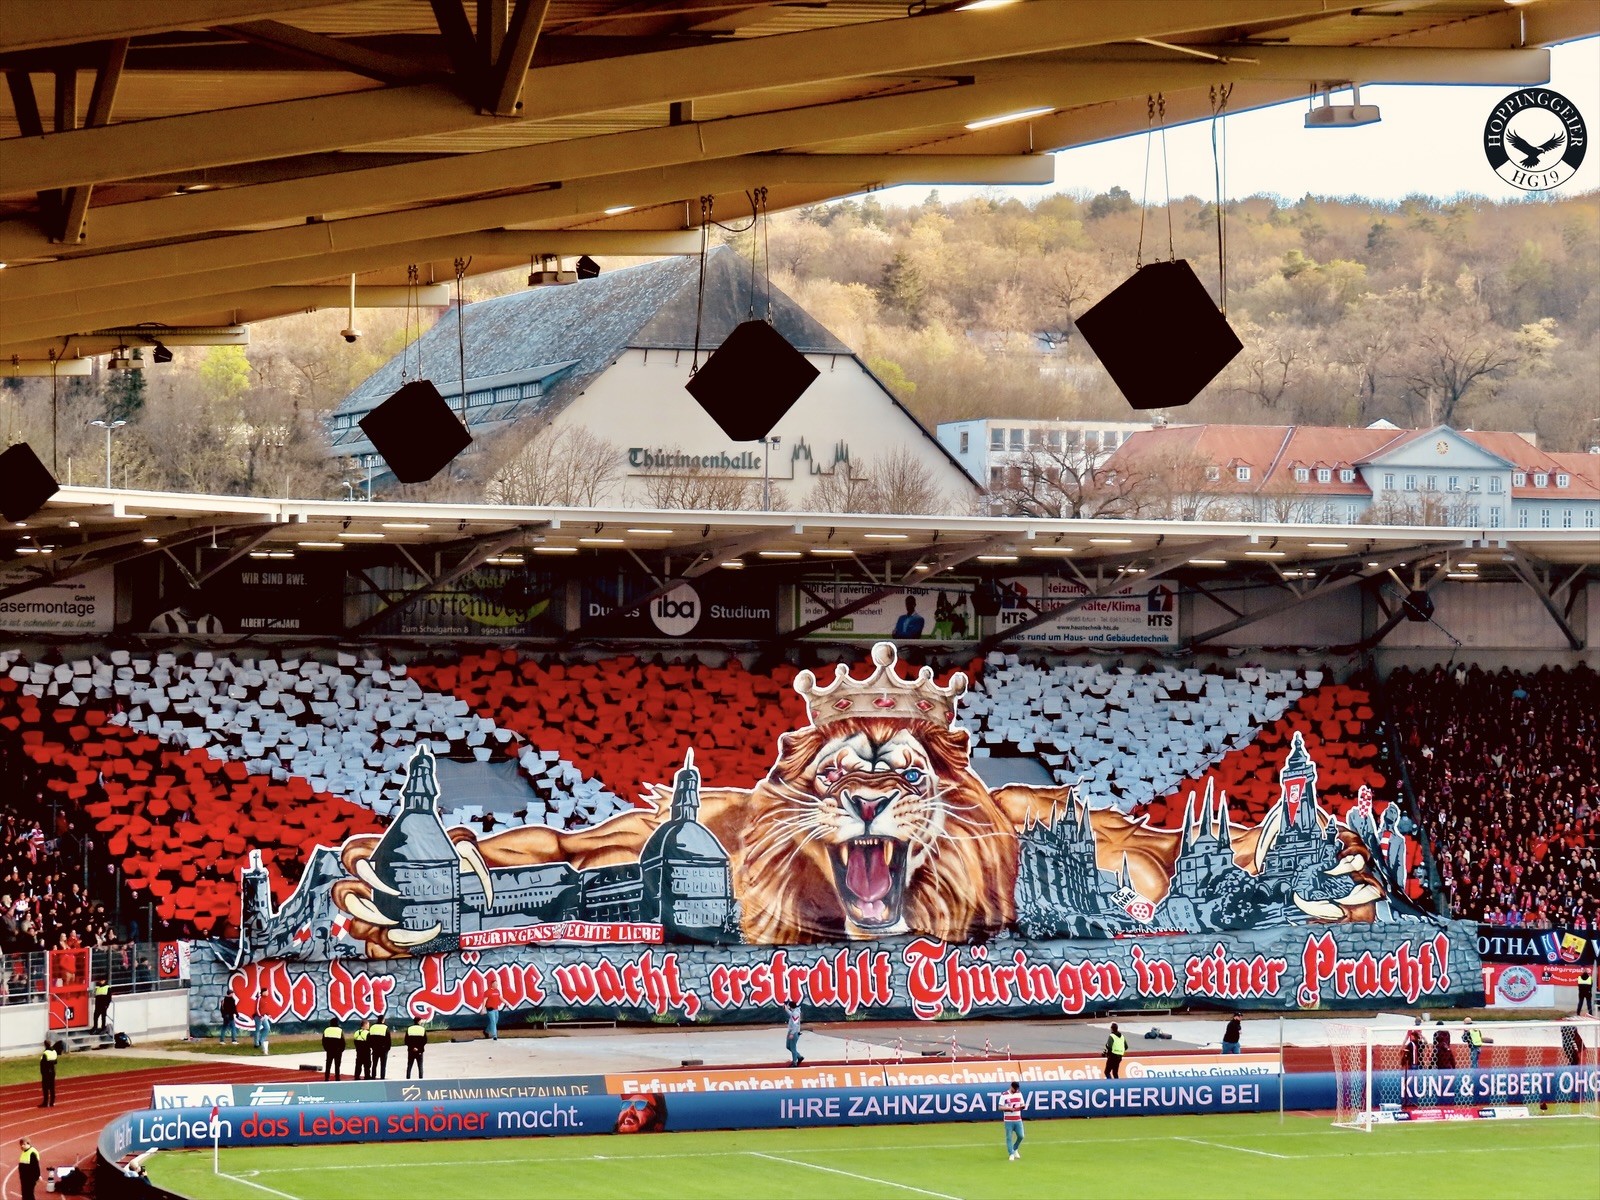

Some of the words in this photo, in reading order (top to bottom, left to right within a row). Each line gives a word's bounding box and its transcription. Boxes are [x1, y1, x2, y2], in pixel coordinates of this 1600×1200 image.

[628, 447, 762, 470] Thüringenhalle
[242, 572, 259, 584] WIR
[262, 573, 283, 585] SIND
[286, 574, 308, 586] RWE.
[657, 595, 695, 618] iba
[710, 604, 771, 619] Studium
[241, 618, 266, 628] ALBERT
[1001, 612, 1028, 624] HTS
[1147, 615, 1173, 627] HTS
[401, 626, 418, 634] Zum
[419, 626, 463, 635] Schulgarten
[481, 628, 503, 636] 99092
[505, 627, 526, 635] Erfurt
[1027, 634, 1047, 642] rund
[1063, 634, 1086, 642] Haus-
[1106, 634, 1170, 643] Gebäudetechnik
[1113, 891, 1125, 901] FC
[1118, 892, 1136, 908] RWE
[462, 926, 550, 947] THÜRINGENS
[566, 923, 612, 940] ECHTE
[618, 925, 661, 941] LIEBE
[1476, 936, 1540, 955] OTHA
[229, 957, 316, 1031] Wo
[325, 957, 397, 1022] der
[408, 951, 545, 1025] Löwe
[553, 948, 701, 1022] wacht,
[710, 948, 896, 1016] erstrahlt
[903, 937, 1125, 1021] Thüringen
[1131, 944, 1178, 1000] in
[1184, 942, 1288, 1000] seiner
[1296, 930, 1450, 1008] Pracht!
[622, 1078, 697, 1094] Erfurt
[703, 1072, 794, 1091] kontert
[801, 1072, 837, 1089] mit
[844, 1064, 1102, 1088] Lichtgeschwindigkeit
[1146, 1067, 1207, 1079] Deutsche
[1209, 1066, 1270, 1078] GigaNetz
[1401, 1075, 1456, 1099] KUNZ
[1460, 1075, 1475, 1097] &
[1479, 1072, 1558, 1096] SIEBERT
[780, 1098, 842, 1119] IHRE
[1221, 1084, 1260, 1105] BEI
[139, 1114, 232, 1145] Lächeln
[240, 1111, 290, 1138] das
[299, 1110, 380, 1138] Leben
[387, 1105, 491, 1135] schöner
[497, 1103, 585, 1130] macht.
